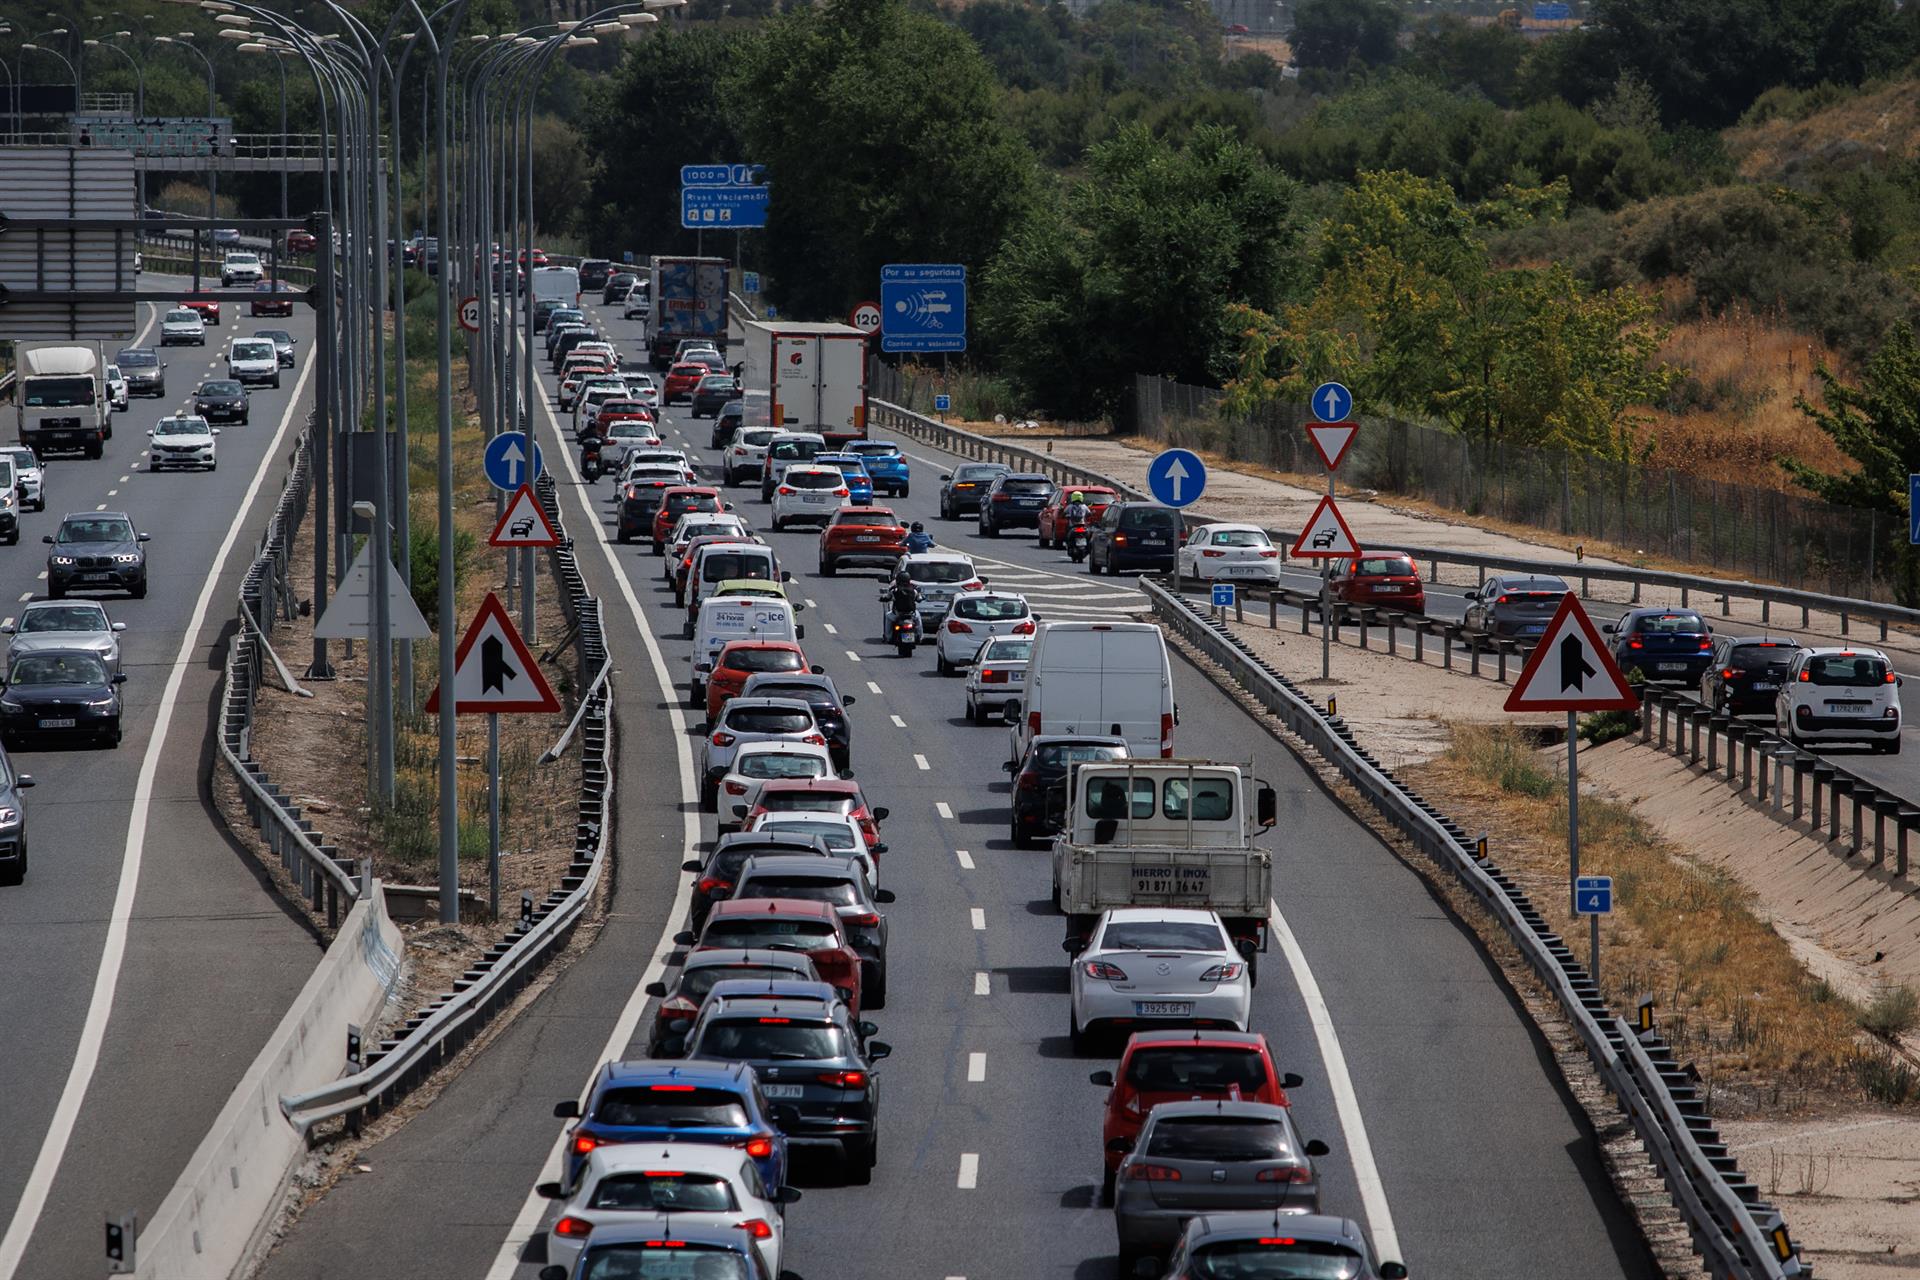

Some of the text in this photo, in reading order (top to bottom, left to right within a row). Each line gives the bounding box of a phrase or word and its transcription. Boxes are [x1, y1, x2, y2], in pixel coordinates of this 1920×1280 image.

[687, 171, 714, 179] 1000
[716, 193, 768, 201] Vaciamadri
[885, 268, 899, 276] Por
[919, 268, 961, 277] seguridad
[463, 308, 478, 320] 12
[855, 313, 880, 325] 120
[1220, 594, 1227, 603] 5
[716, 613, 745, 621] 24 horas
[768, 612, 784, 622] ice
[1132, 868, 1211, 879] HIERRO E INOX.
[1138, 880, 1150, 891] 91
[1154, 880, 1172, 892] 871
[1191, 881, 1204, 892] 47
[1588, 894, 1600, 908] 4
[1144, 1002, 1168, 1013] 3925
